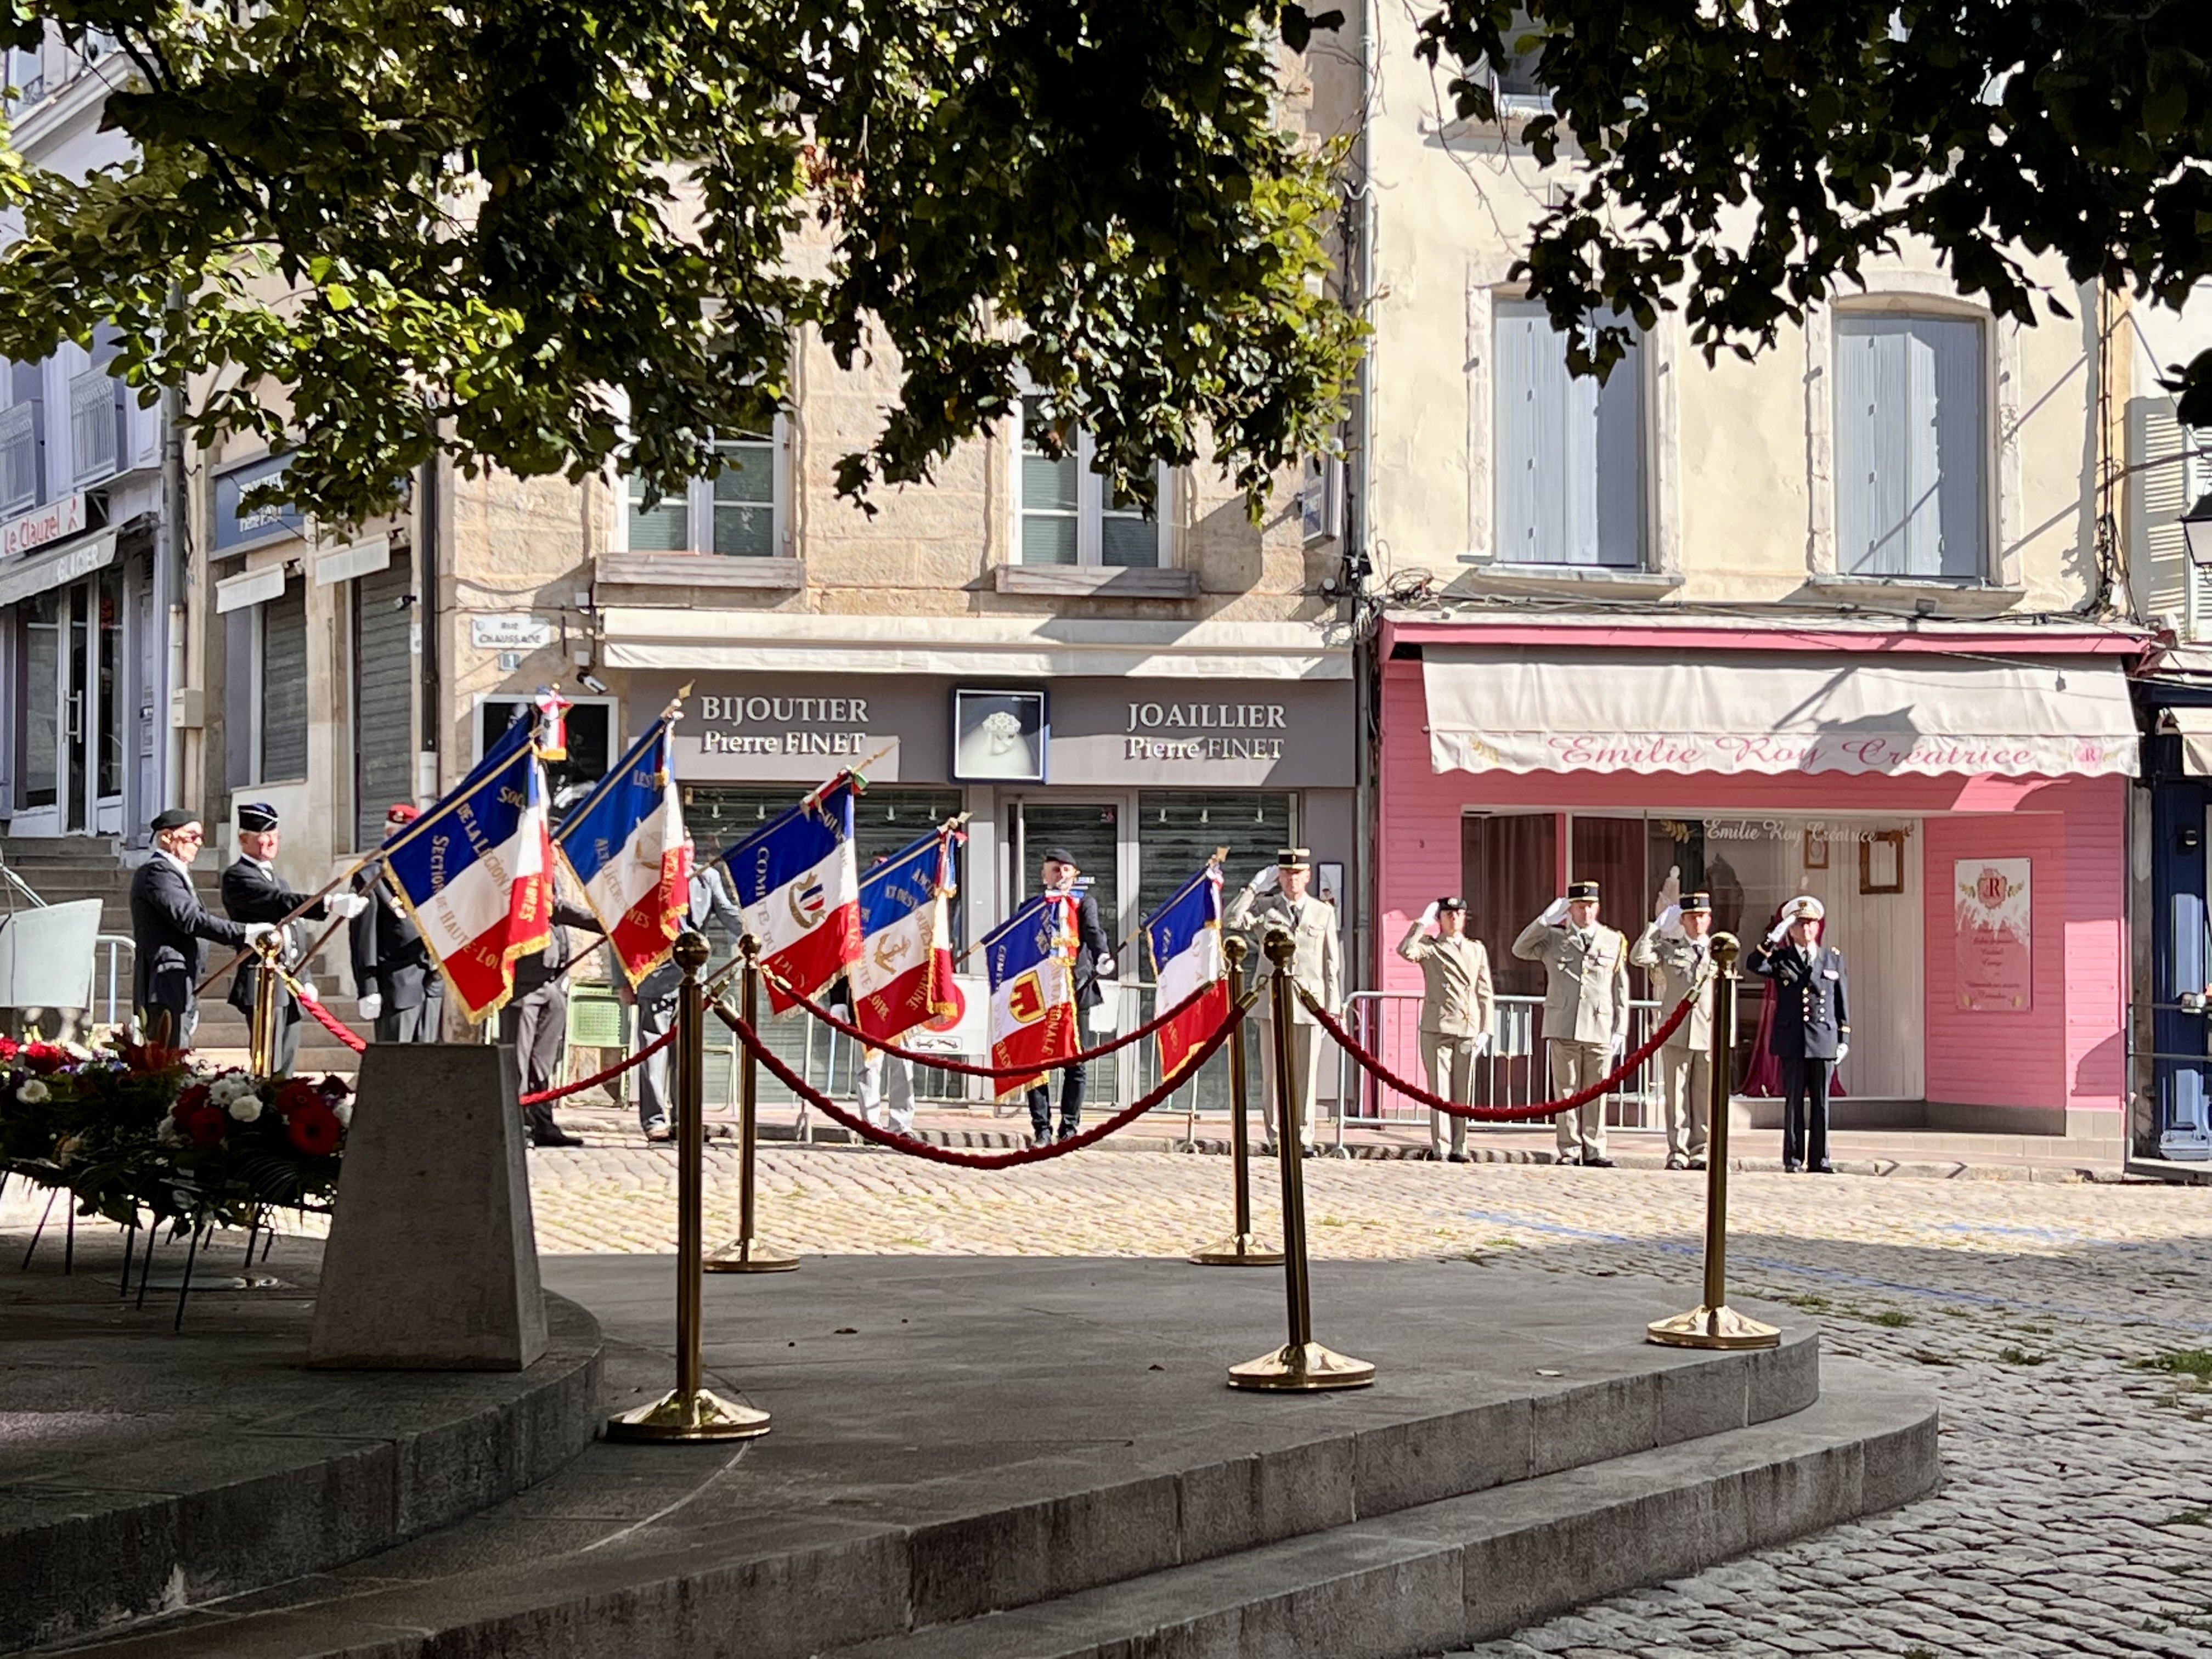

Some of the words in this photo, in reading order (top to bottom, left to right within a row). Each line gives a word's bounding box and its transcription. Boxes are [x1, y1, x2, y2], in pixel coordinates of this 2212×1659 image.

[4, 528, 17, 555] Le
[19, 505, 60, 548] Clauzel
[701, 696, 869, 726] BIJOUTIER
[1126, 703, 1287, 732] JOAILLIER
[702, 730, 778, 753] Pierre
[784, 732, 867, 754] FINET
[1127, 737, 1200, 758] Pierre
[1207, 738, 1285, 759] FINET
[1547, 735, 1706, 765] Emilie
[1714, 736, 1826, 769] Roy
[1841, 738, 2036, 766] Créatrice
[464, 821, 482, 843] LA
[1702, 818, 1760, 841] Emilie
[1762, 820, 1806, 848] Roy
[1807, 821, 1878, 843] Créatrice
